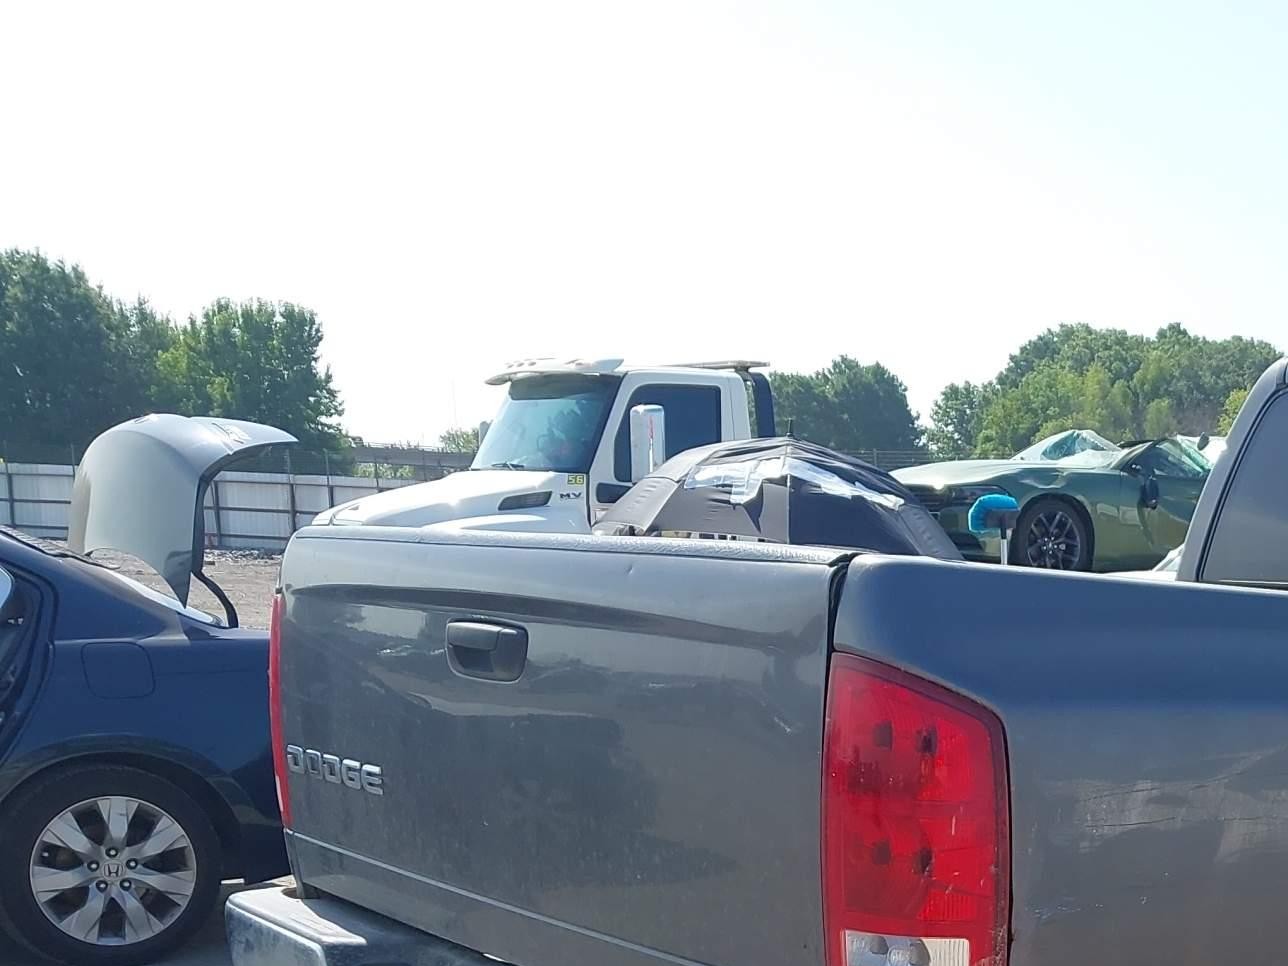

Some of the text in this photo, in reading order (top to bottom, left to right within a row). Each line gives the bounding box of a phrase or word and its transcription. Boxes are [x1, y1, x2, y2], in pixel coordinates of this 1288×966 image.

[567, 474, 585, 485] 56
[559, 491, 582, 499] MV
[285, 743, 385, 796] DODGE
